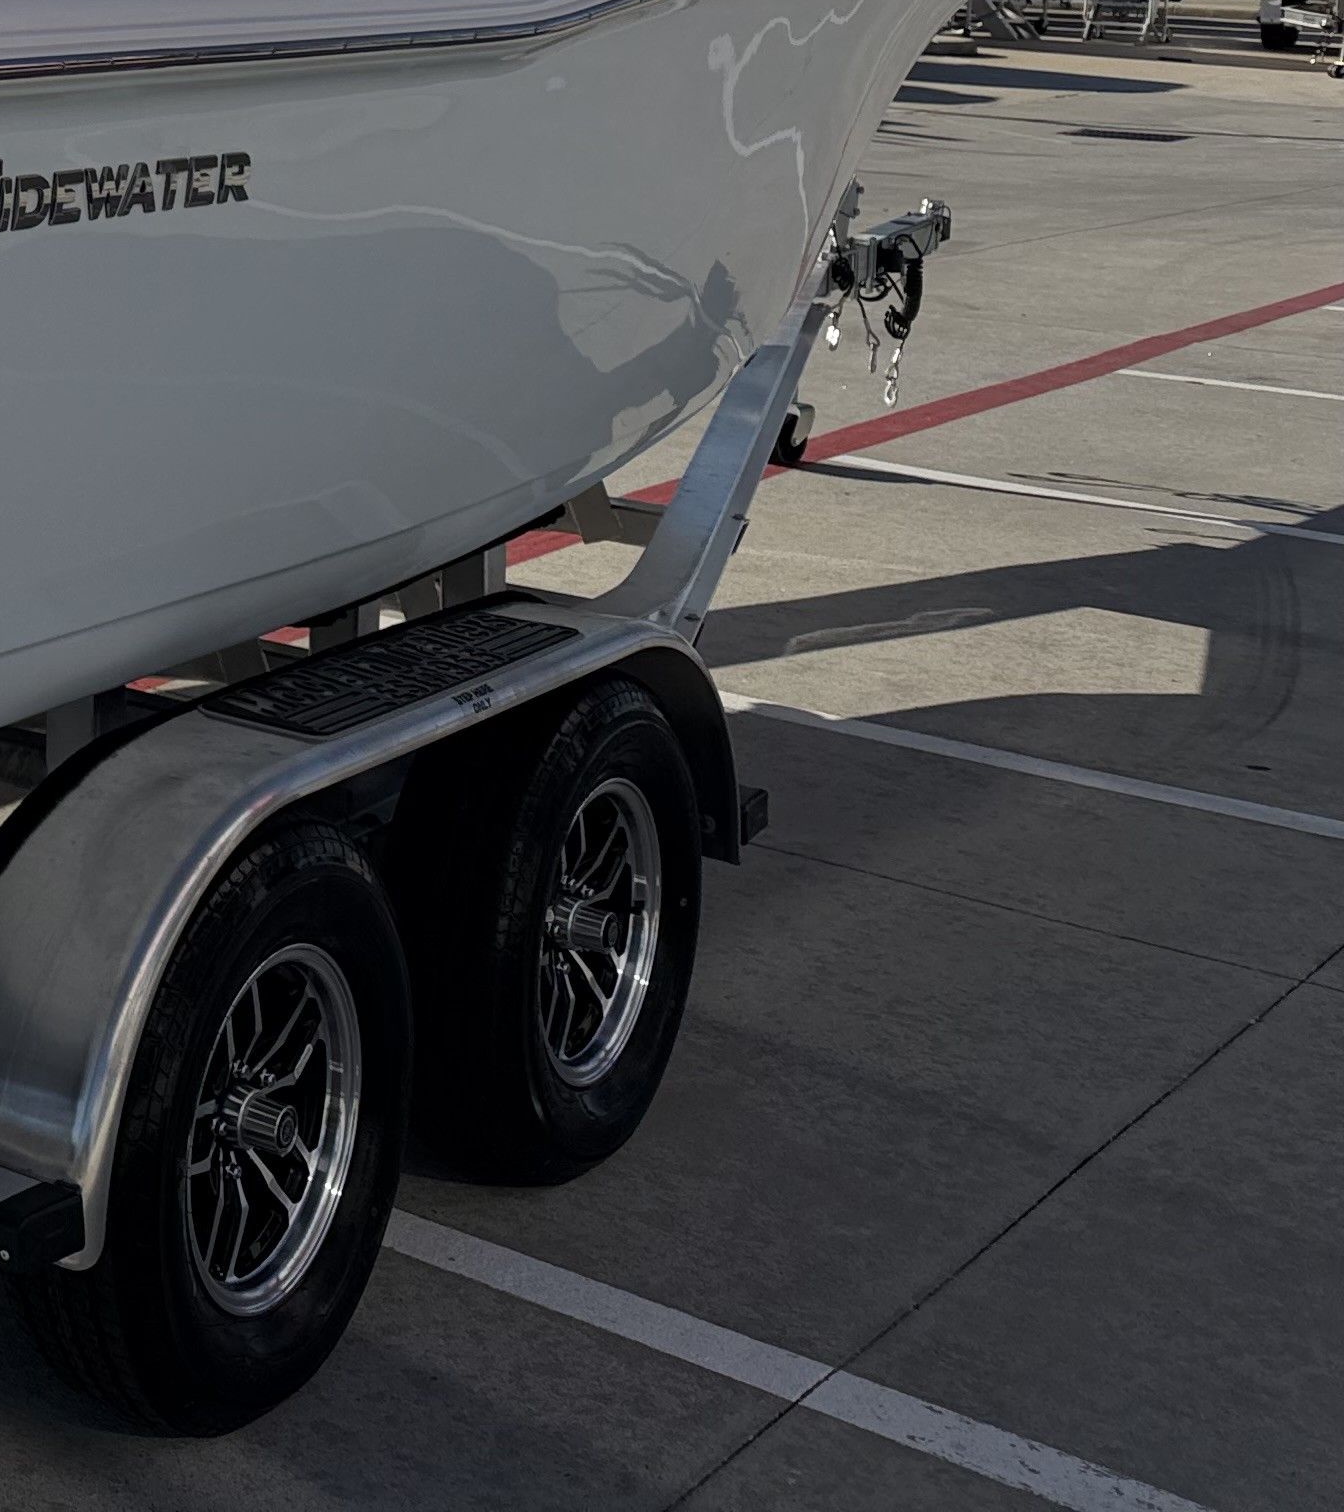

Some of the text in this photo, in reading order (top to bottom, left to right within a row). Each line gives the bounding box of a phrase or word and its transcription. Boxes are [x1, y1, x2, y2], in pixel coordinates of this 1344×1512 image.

[451, 684, 494, 706] STEP HERE
[472, 696, 492, 714] ONLY
